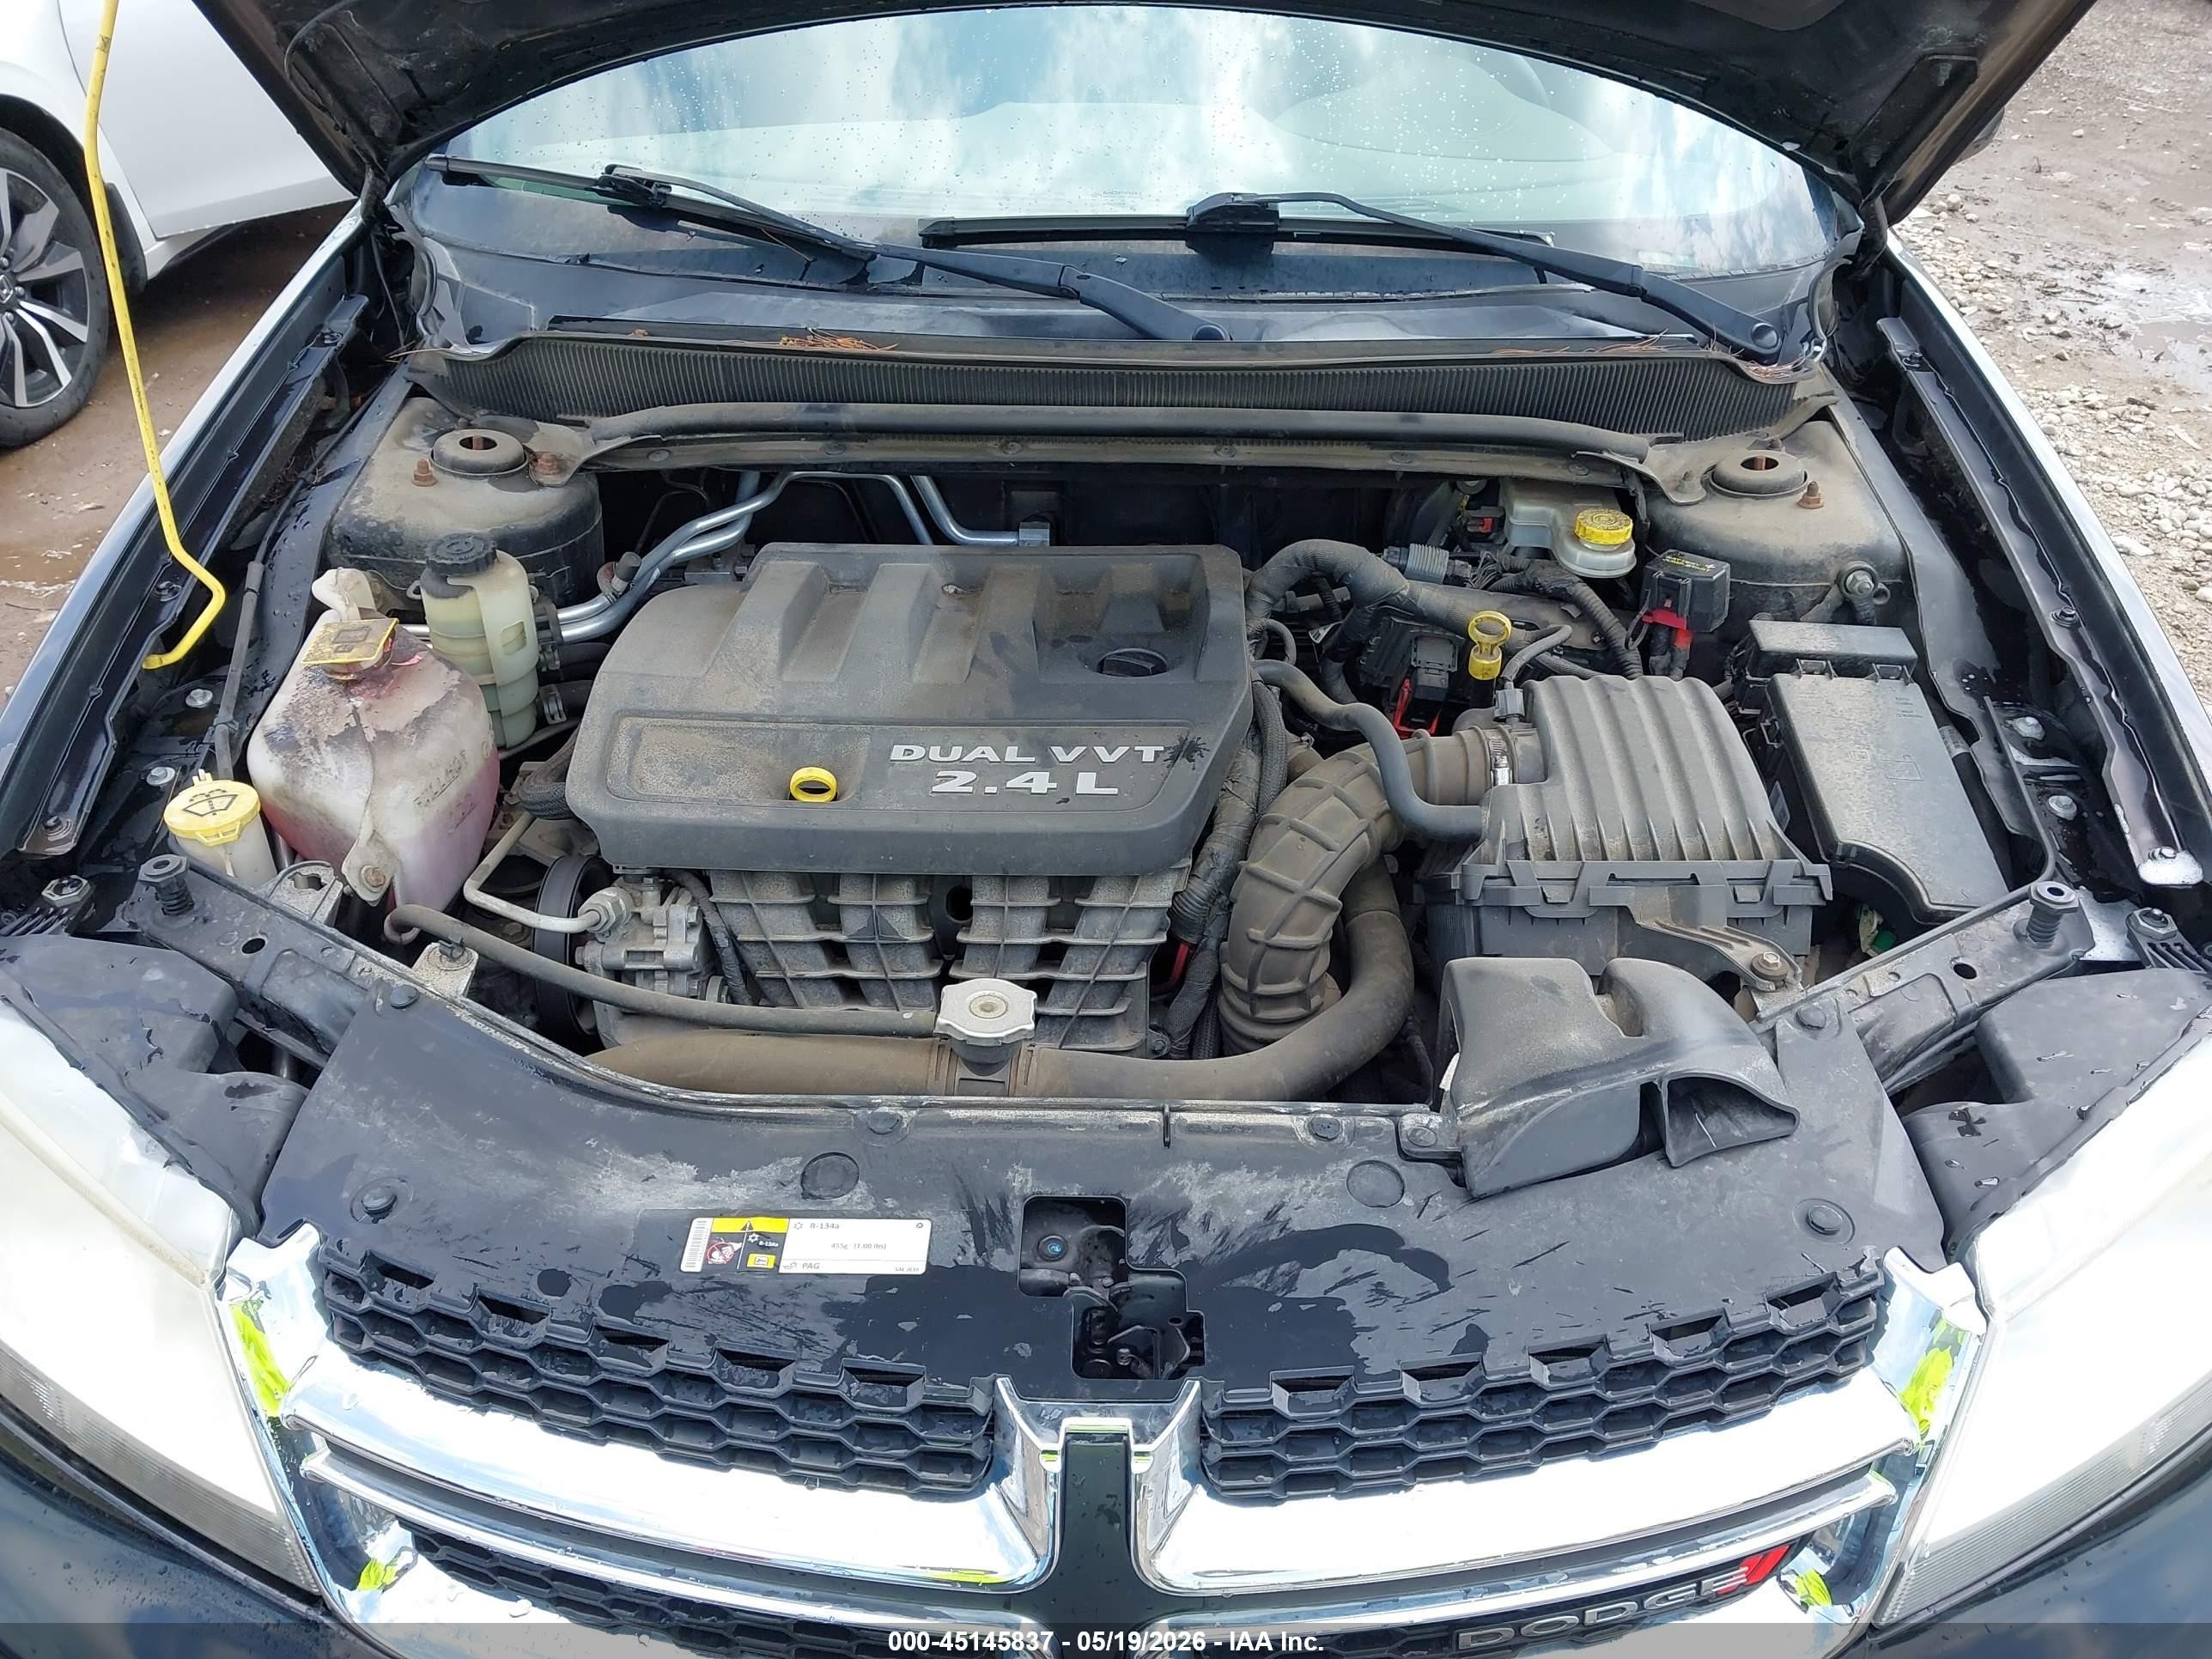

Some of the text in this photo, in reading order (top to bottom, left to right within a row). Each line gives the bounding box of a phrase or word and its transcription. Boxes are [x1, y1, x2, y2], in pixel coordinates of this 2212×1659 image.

[890, 744, 1164, 763] DUAL VVT
[1456, 1565, 1750, 1650] DODGE
